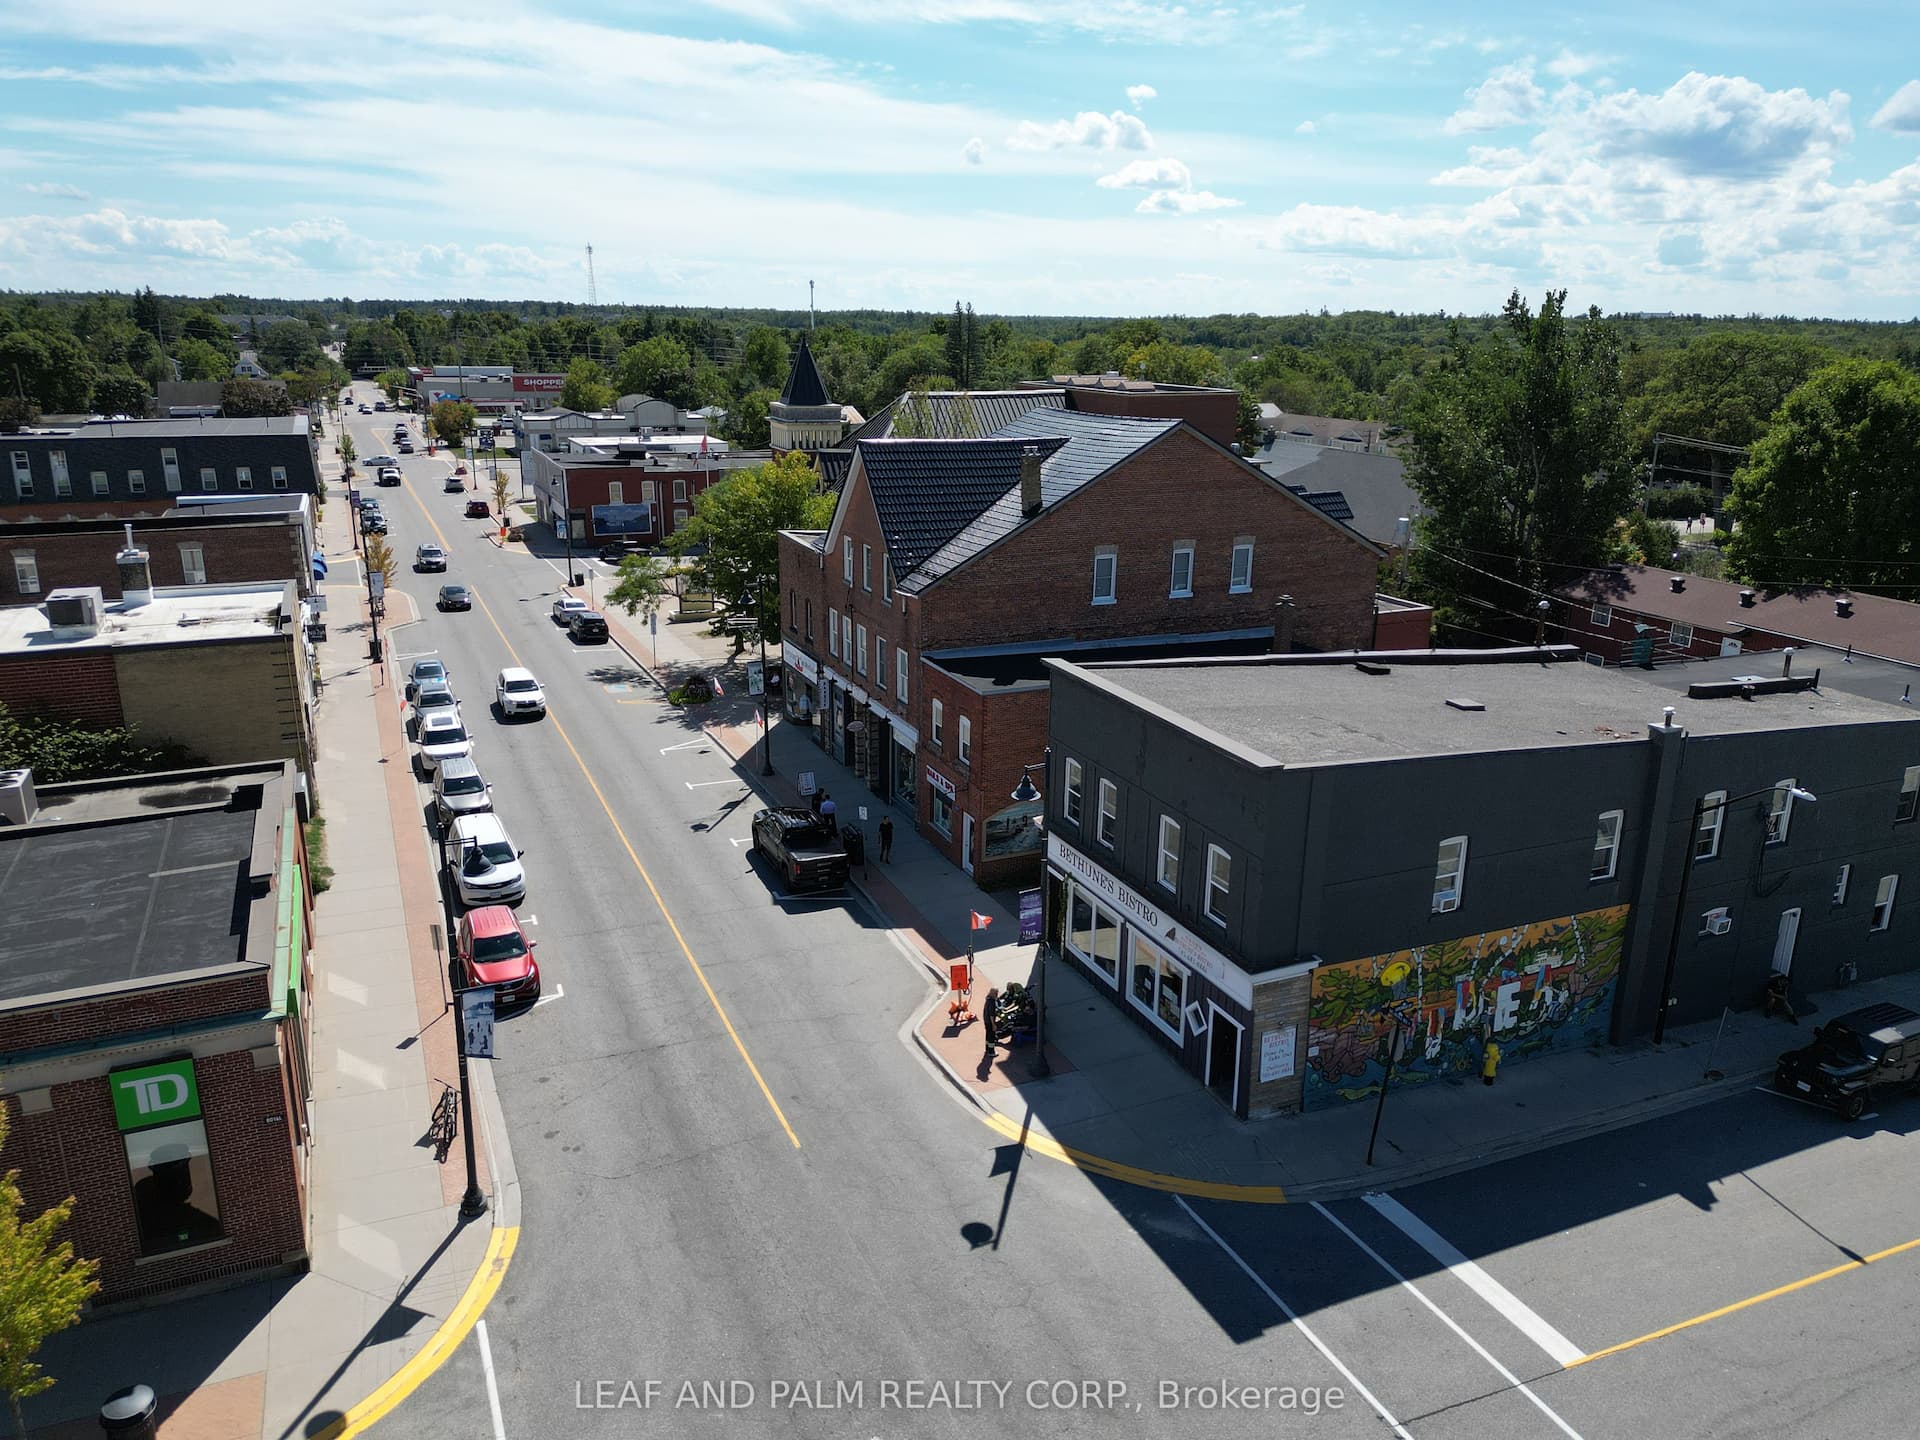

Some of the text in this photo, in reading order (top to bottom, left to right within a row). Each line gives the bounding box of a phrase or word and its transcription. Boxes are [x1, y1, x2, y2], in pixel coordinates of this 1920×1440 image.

[1060, 844, 1158, 927] BETHUNE'S BISTRO
[120, 1073, 189, 1115] TD
